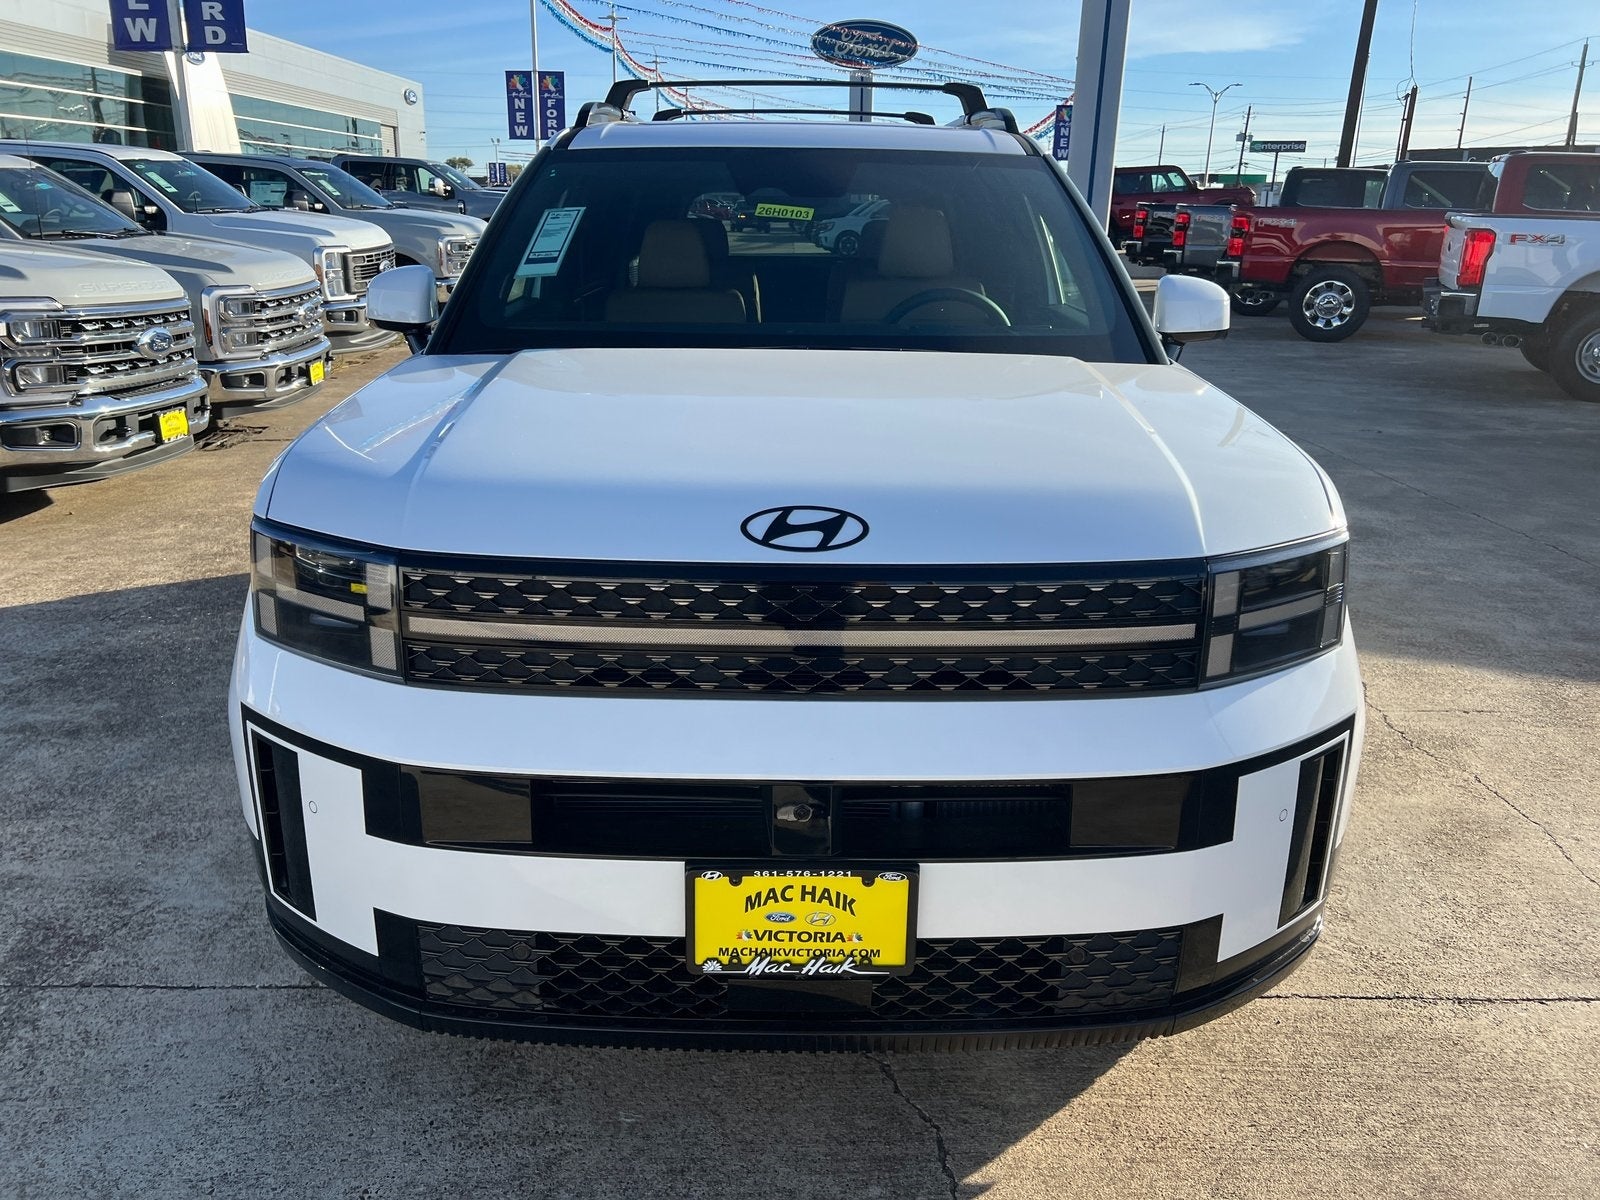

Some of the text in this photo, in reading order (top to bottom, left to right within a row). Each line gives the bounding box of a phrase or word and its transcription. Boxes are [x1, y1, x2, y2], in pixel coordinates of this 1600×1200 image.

[834, 31, 895, 58] Ford
[514, 99, 528, 136] NEW
[1057, 127, 1069, 158] NEW
[1252, 143, 1306, 152] enterprise
[757, 206, 810, 219] 26H0103
[1509, 233, 1566, 246] FX4
[744, 884, 857, 917] MAC HAIK
[752, 929, 847, 943] VICTORIA
[745, 955, 860, 976] Mac Haik
